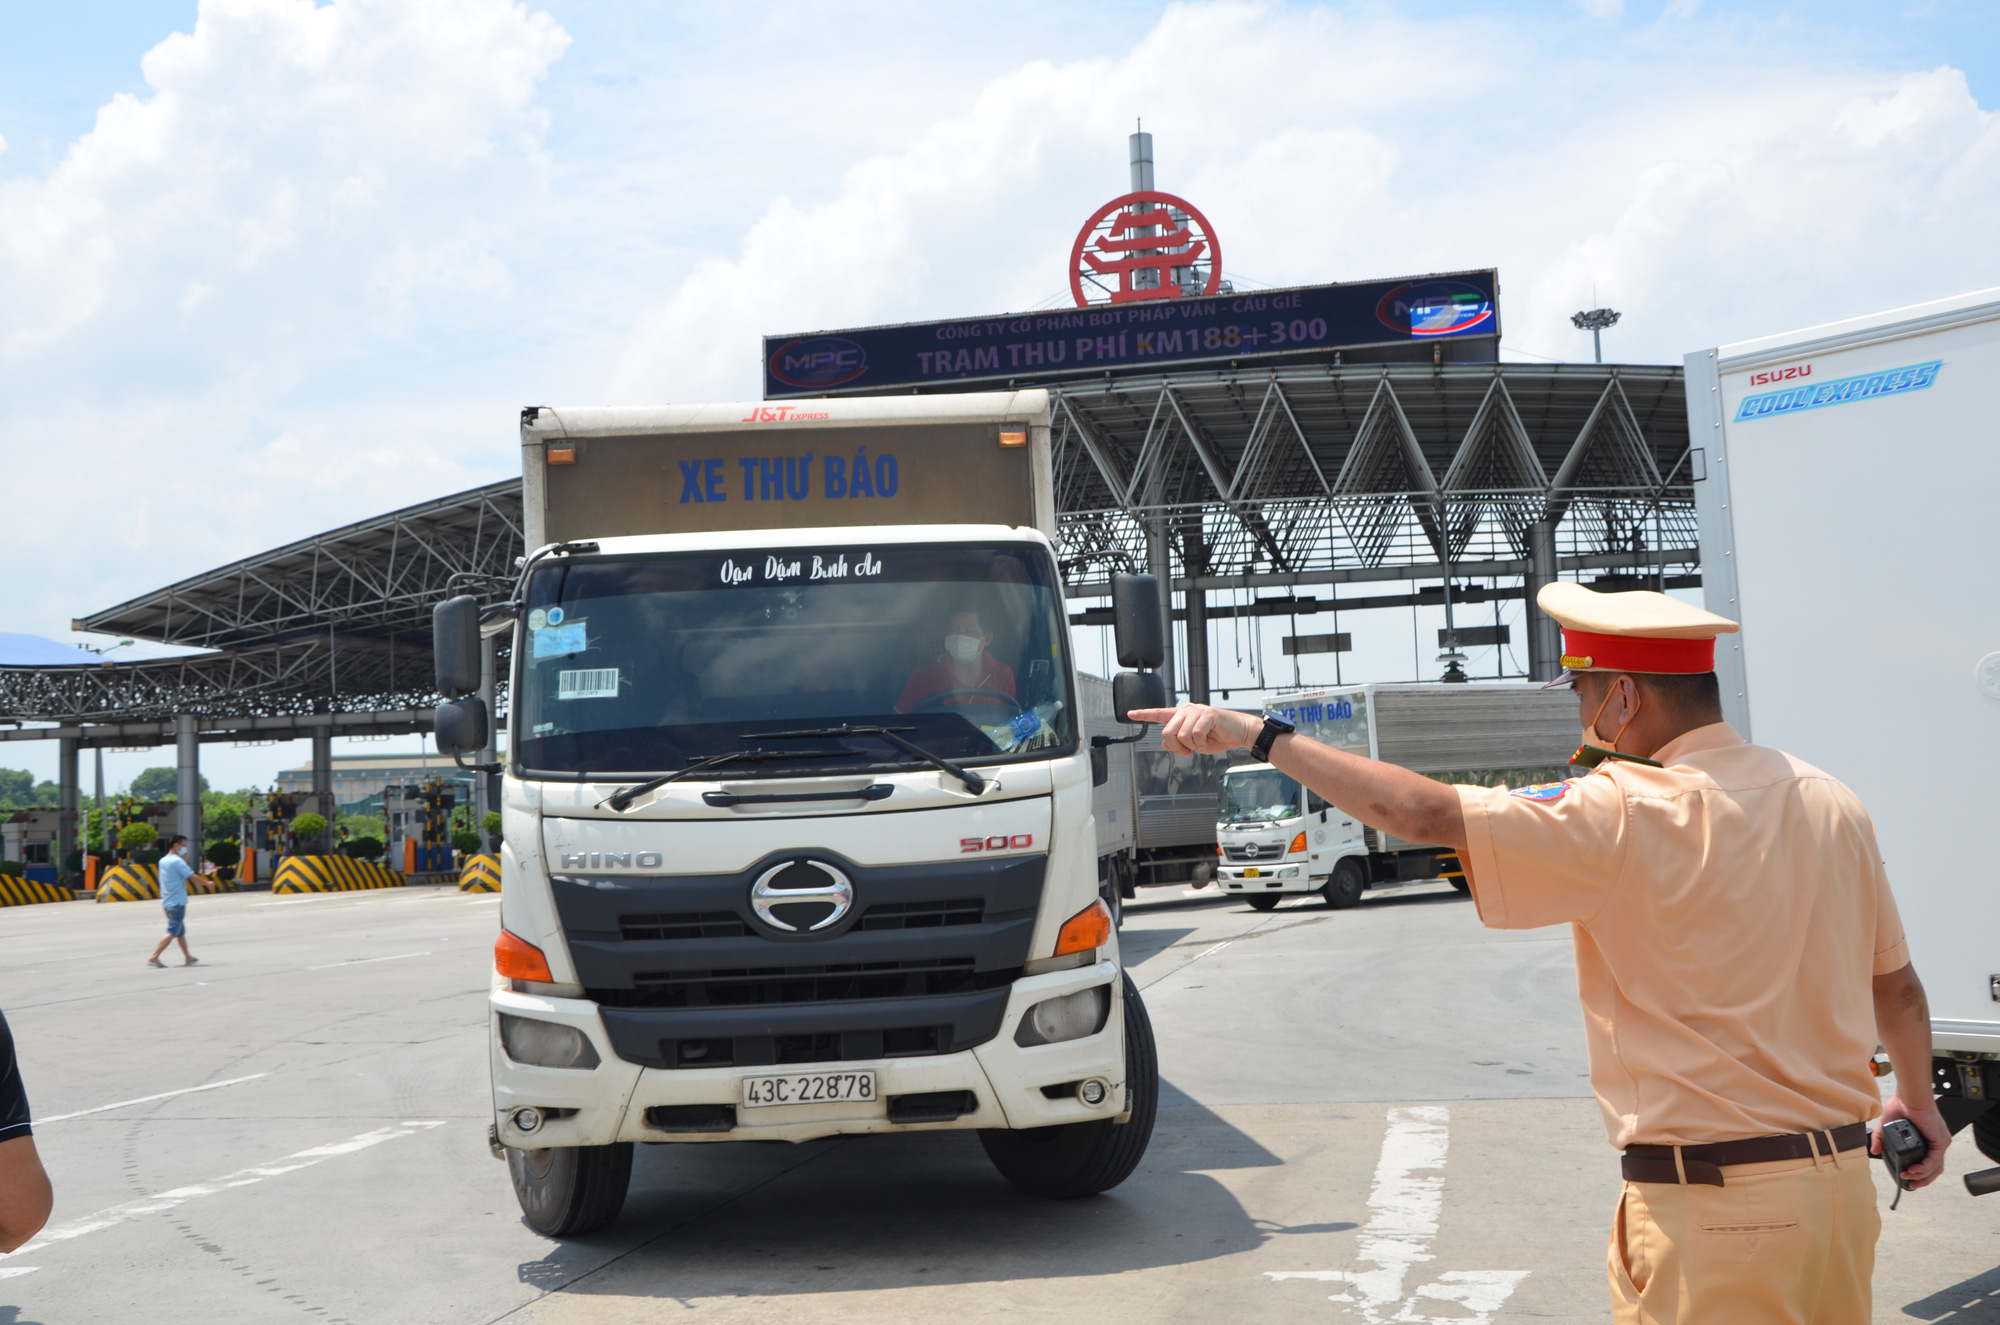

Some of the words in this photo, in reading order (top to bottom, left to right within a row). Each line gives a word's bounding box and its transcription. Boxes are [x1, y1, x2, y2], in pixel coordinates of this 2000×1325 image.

[1394, 293, 1479, 317] MPC
[936, 324, 981, 340] CÔNG
[985, 321, 1006, 336] TY
[1089, 311, 1123, 327] BOT
[1128, 304, 1176, 323] PHÁP
[1180, 301, 1217, 318] VÂN
[916, 346, 1000, 377] TRẠM
[1006, 340, 1066, 367] THU
[1076, 330, 1129, 361] PHÍ
[1136, 317, 1328, 356] KM188+300
[784, 349, 857, 371] MPC
[1750, 364, 1811, 387] ISUZU
[1740, 388, 1809, 418] COOL
[1810, 364, 1939, 407] EXPRESS
[741, 406, 797, 422] J&T
[789, 412, 830, 421] EXPRESS
[678, 459, 727, 504] XE
[738, 452, 814, 502] THƯ
[824, 445, 899, 499] BÁO
[1299, 702, 1323, 724] THƯ
[1327, 698, 1352, 721] BÁO
[960, 833, 1033, 853] 500
[561, 850, 663, 869] HINO
